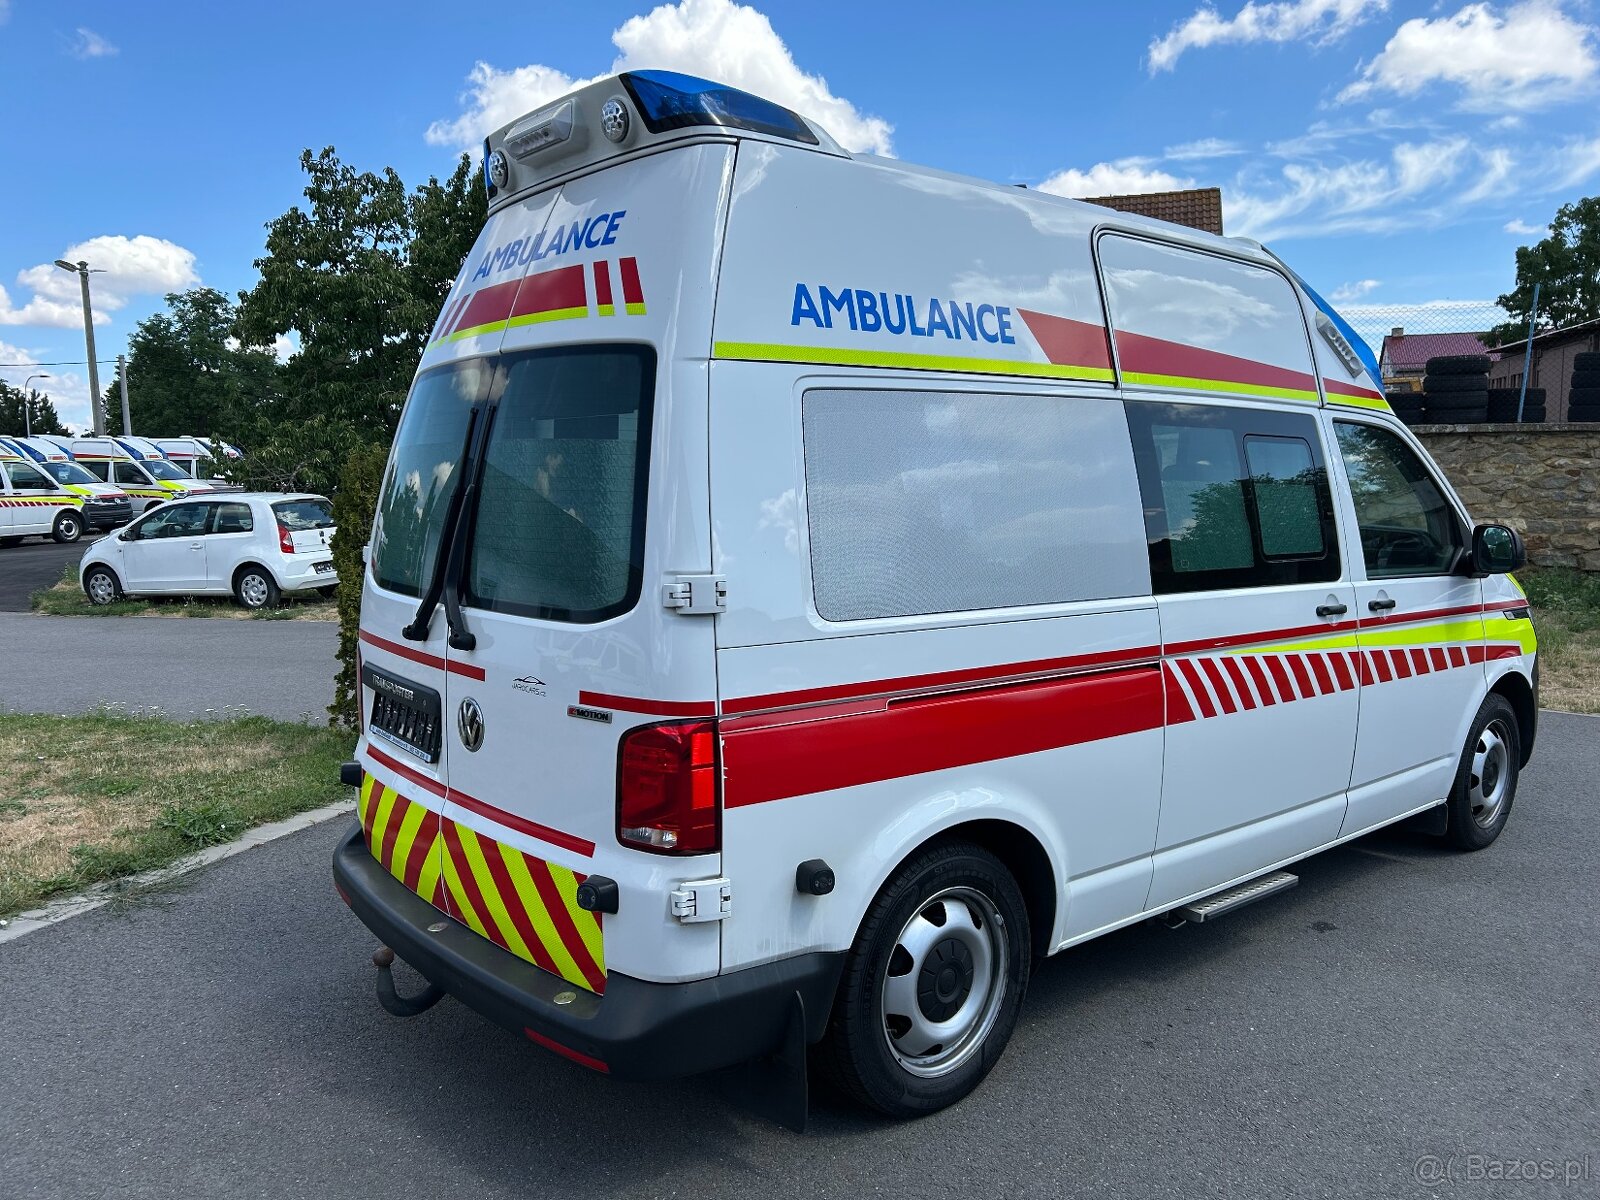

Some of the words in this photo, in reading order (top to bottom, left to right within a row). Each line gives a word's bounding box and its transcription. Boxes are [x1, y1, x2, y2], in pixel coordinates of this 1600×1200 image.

[473, 209, 627, 282] AMBULANCE
[792, 282, 1016, 345] AMBULANCE
[372, 673, 414, 700] TRANSPORTER
